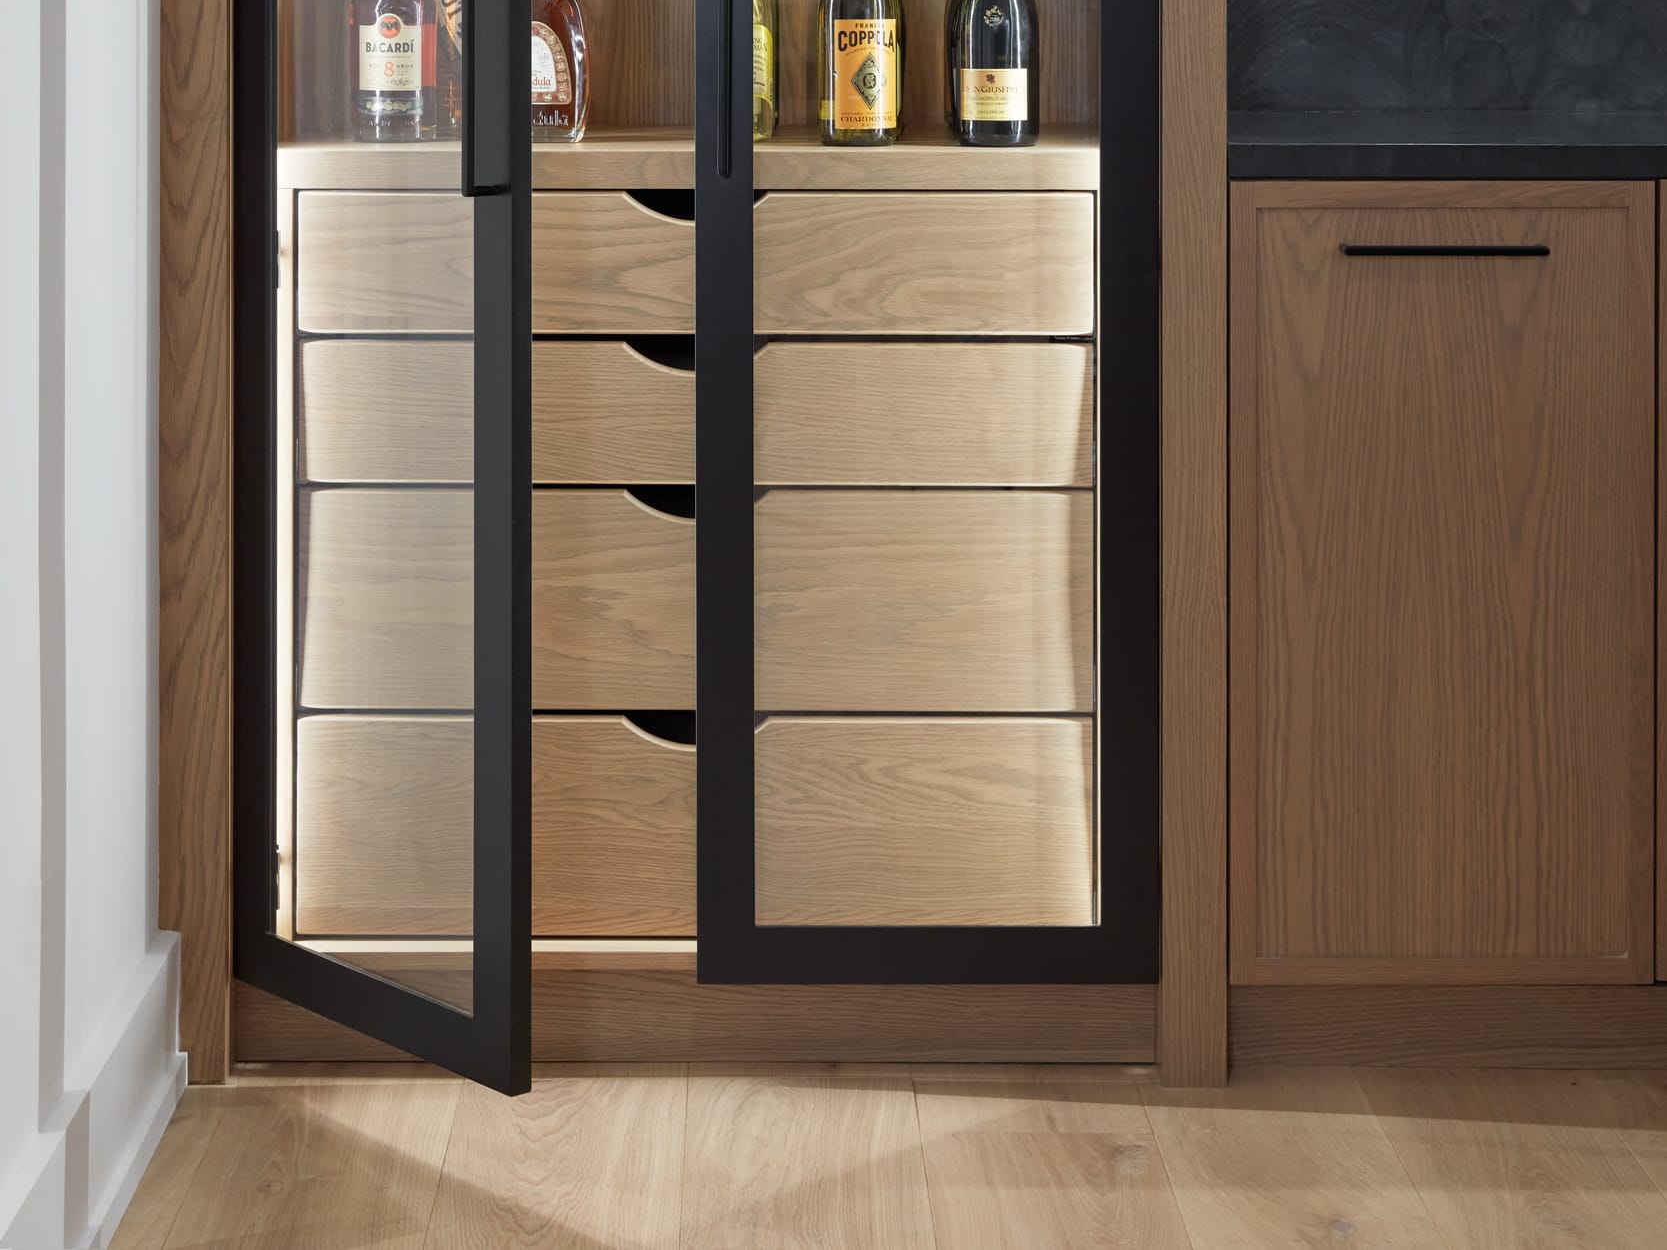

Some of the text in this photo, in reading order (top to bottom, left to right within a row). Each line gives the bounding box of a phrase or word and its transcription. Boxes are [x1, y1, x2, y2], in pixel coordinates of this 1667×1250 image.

[365, 39, 414, 53] BACARDÍ
[837, 30, 895, 53] COPPOLA
[384, 61, 394, 77] 8
[532, 76, 551, 86] dula
[840, 115, 893, 124] CHARDONAY
